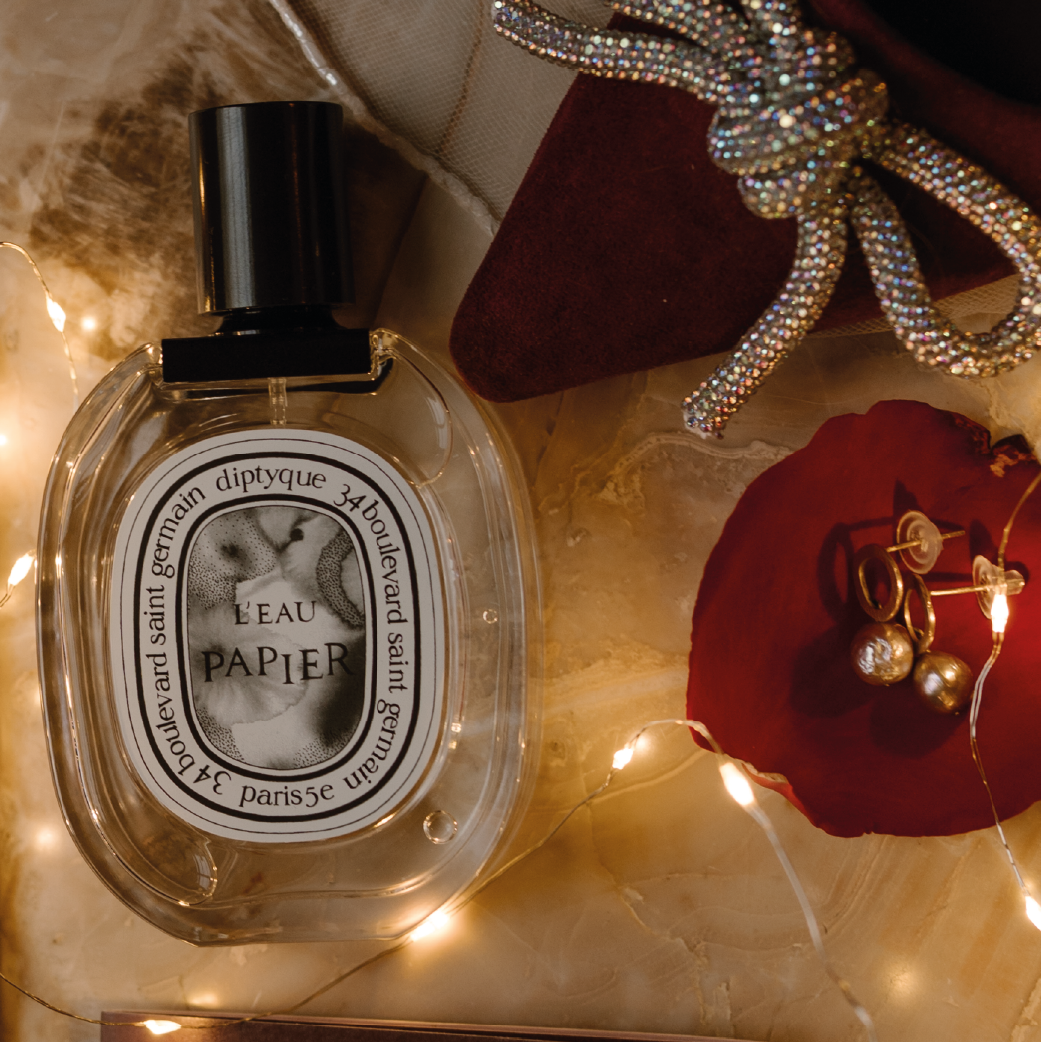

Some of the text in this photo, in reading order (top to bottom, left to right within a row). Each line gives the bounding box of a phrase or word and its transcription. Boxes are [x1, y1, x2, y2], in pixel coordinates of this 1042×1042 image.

[215, 465, 327, 492] diptyque
[152, 486, 207, 579] germain
[142, 584, 166, 646] saint
[234, 600, 318, 626] L'EAU
[201, 641, 356, 685] PAPIER
[387, 631, 410, 694] saint
[342, 698, 402, 791] germain
